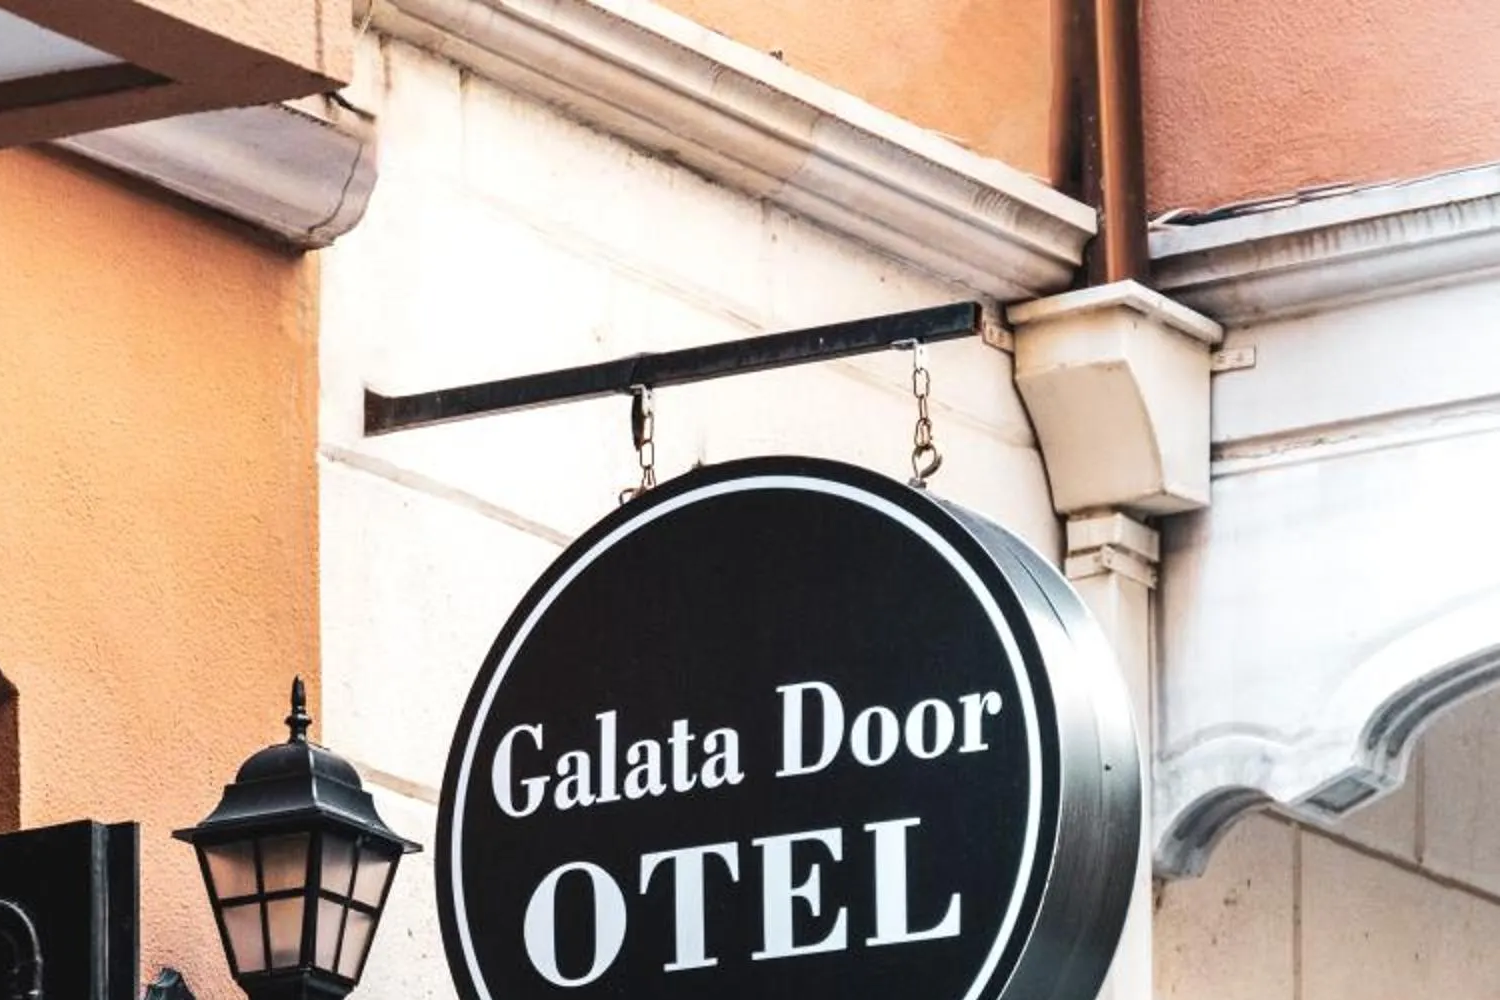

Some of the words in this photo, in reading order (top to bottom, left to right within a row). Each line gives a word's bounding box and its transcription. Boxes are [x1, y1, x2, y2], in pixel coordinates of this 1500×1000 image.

[491, 709, 745, 818] Galata
[775, 681, 1003, 778] Door
[523, 817, 961, 988] OTEL
